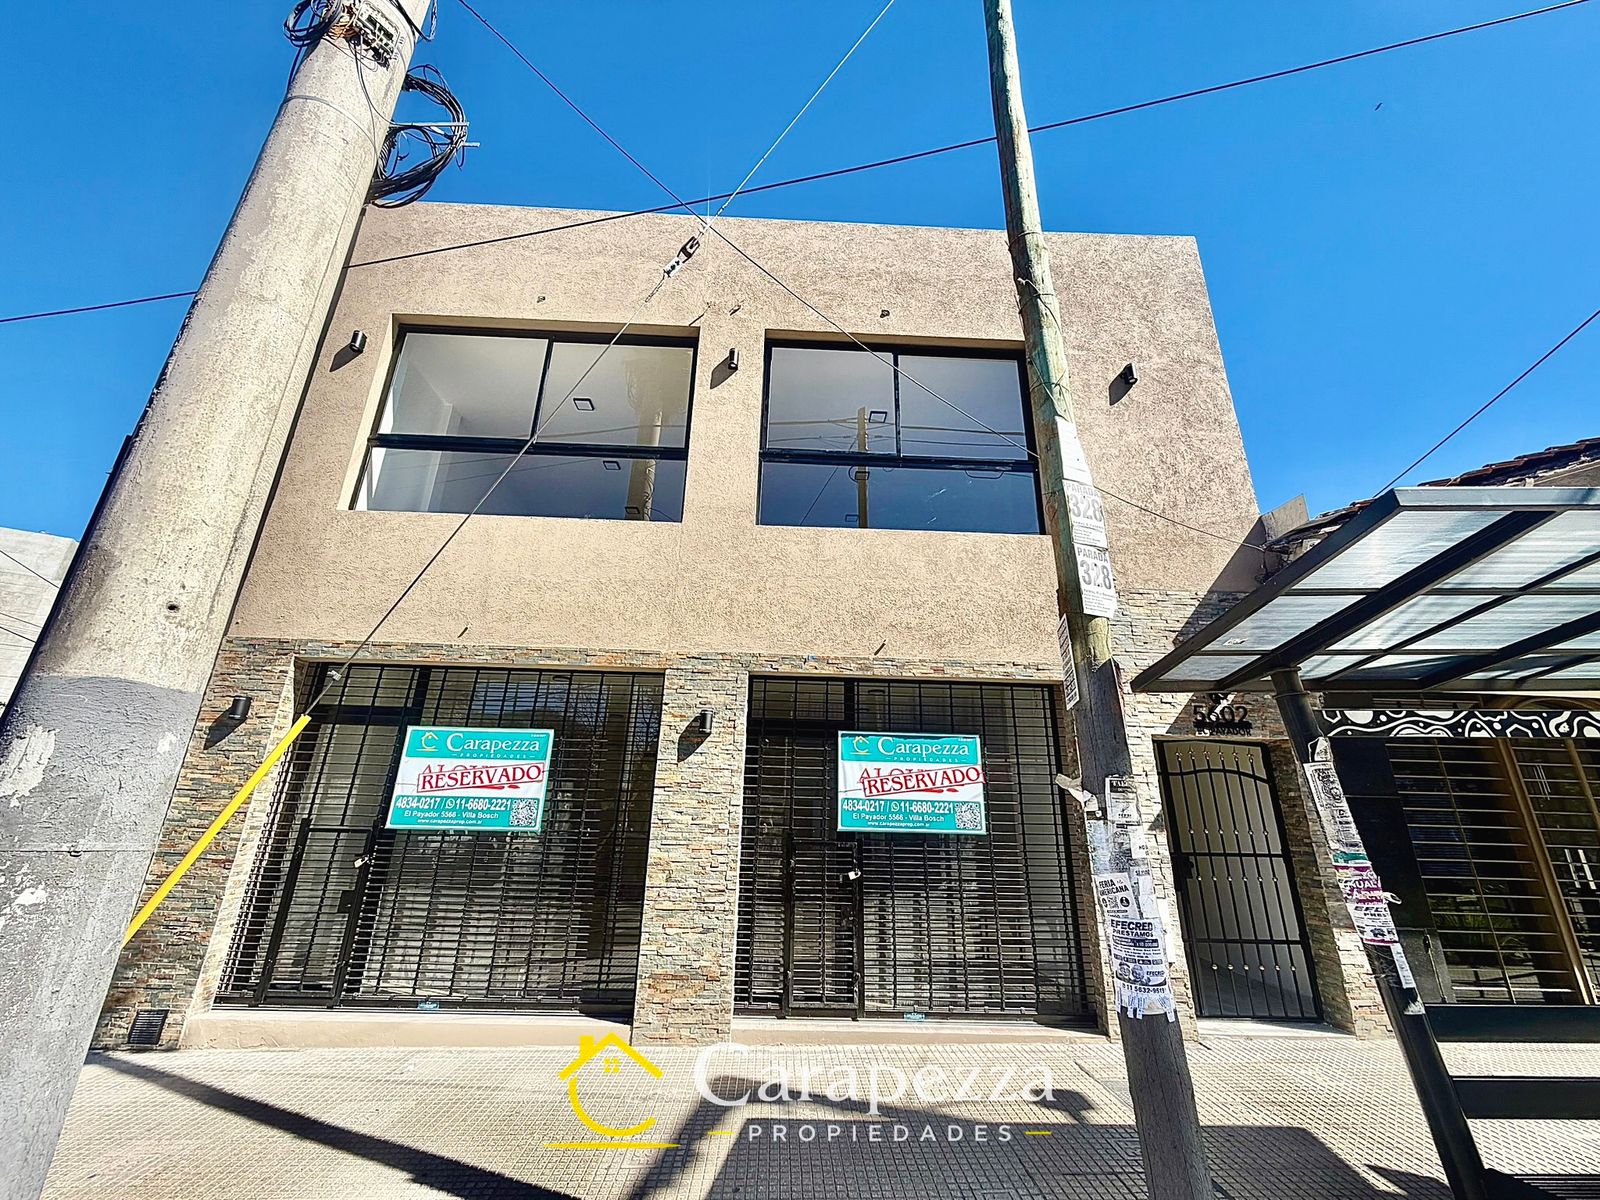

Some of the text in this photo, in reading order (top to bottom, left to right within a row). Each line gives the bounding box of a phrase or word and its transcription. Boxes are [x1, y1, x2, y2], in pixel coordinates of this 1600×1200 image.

[1066, 482, 1099, 498] PARADA
[1070, 493, 1102, 522] 328
[1076, 546, 1109, 564] PARADA
[1080, 560, 1112, 590] 328
[446, 733, 540, 752] Carapezza
[877, 737, 969, 757] Carapezza
[421, 765, 542, 790] RESERVADO
[867, 766, 980, 794] RESERVADO
[396, 797, 441, 809] 4834-0217
[456, 799, 511, 811] 11-6680-2221
[842, 801, 885, 812] 4834-0217
[900, 802, 954, 813] 11-6680-2221
[861, 813, 887, 821] Payador
[1099, 879, 1116, 889] FERIA
[1111, 919, 1153, 931] EFECRED
[1113, 929, 1154, 937] PRESTAMOS
